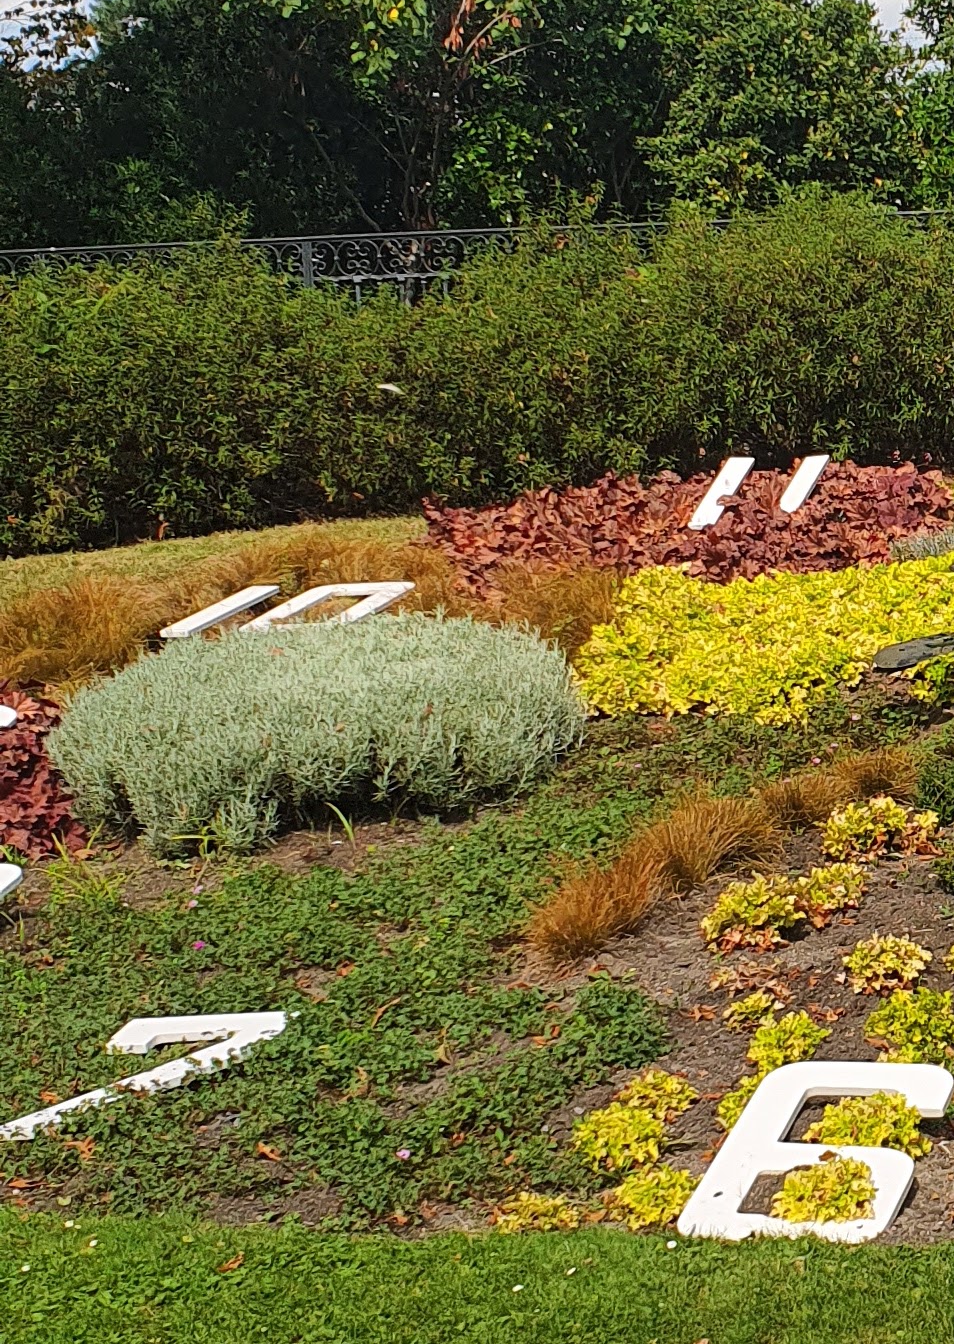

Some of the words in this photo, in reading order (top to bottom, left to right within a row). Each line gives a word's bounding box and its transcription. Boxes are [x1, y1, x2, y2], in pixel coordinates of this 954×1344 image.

[688, 454, 830, 530] 11
[0, 1010, 300, 1141] 7
[677, 1061, 954, 1244] 6
